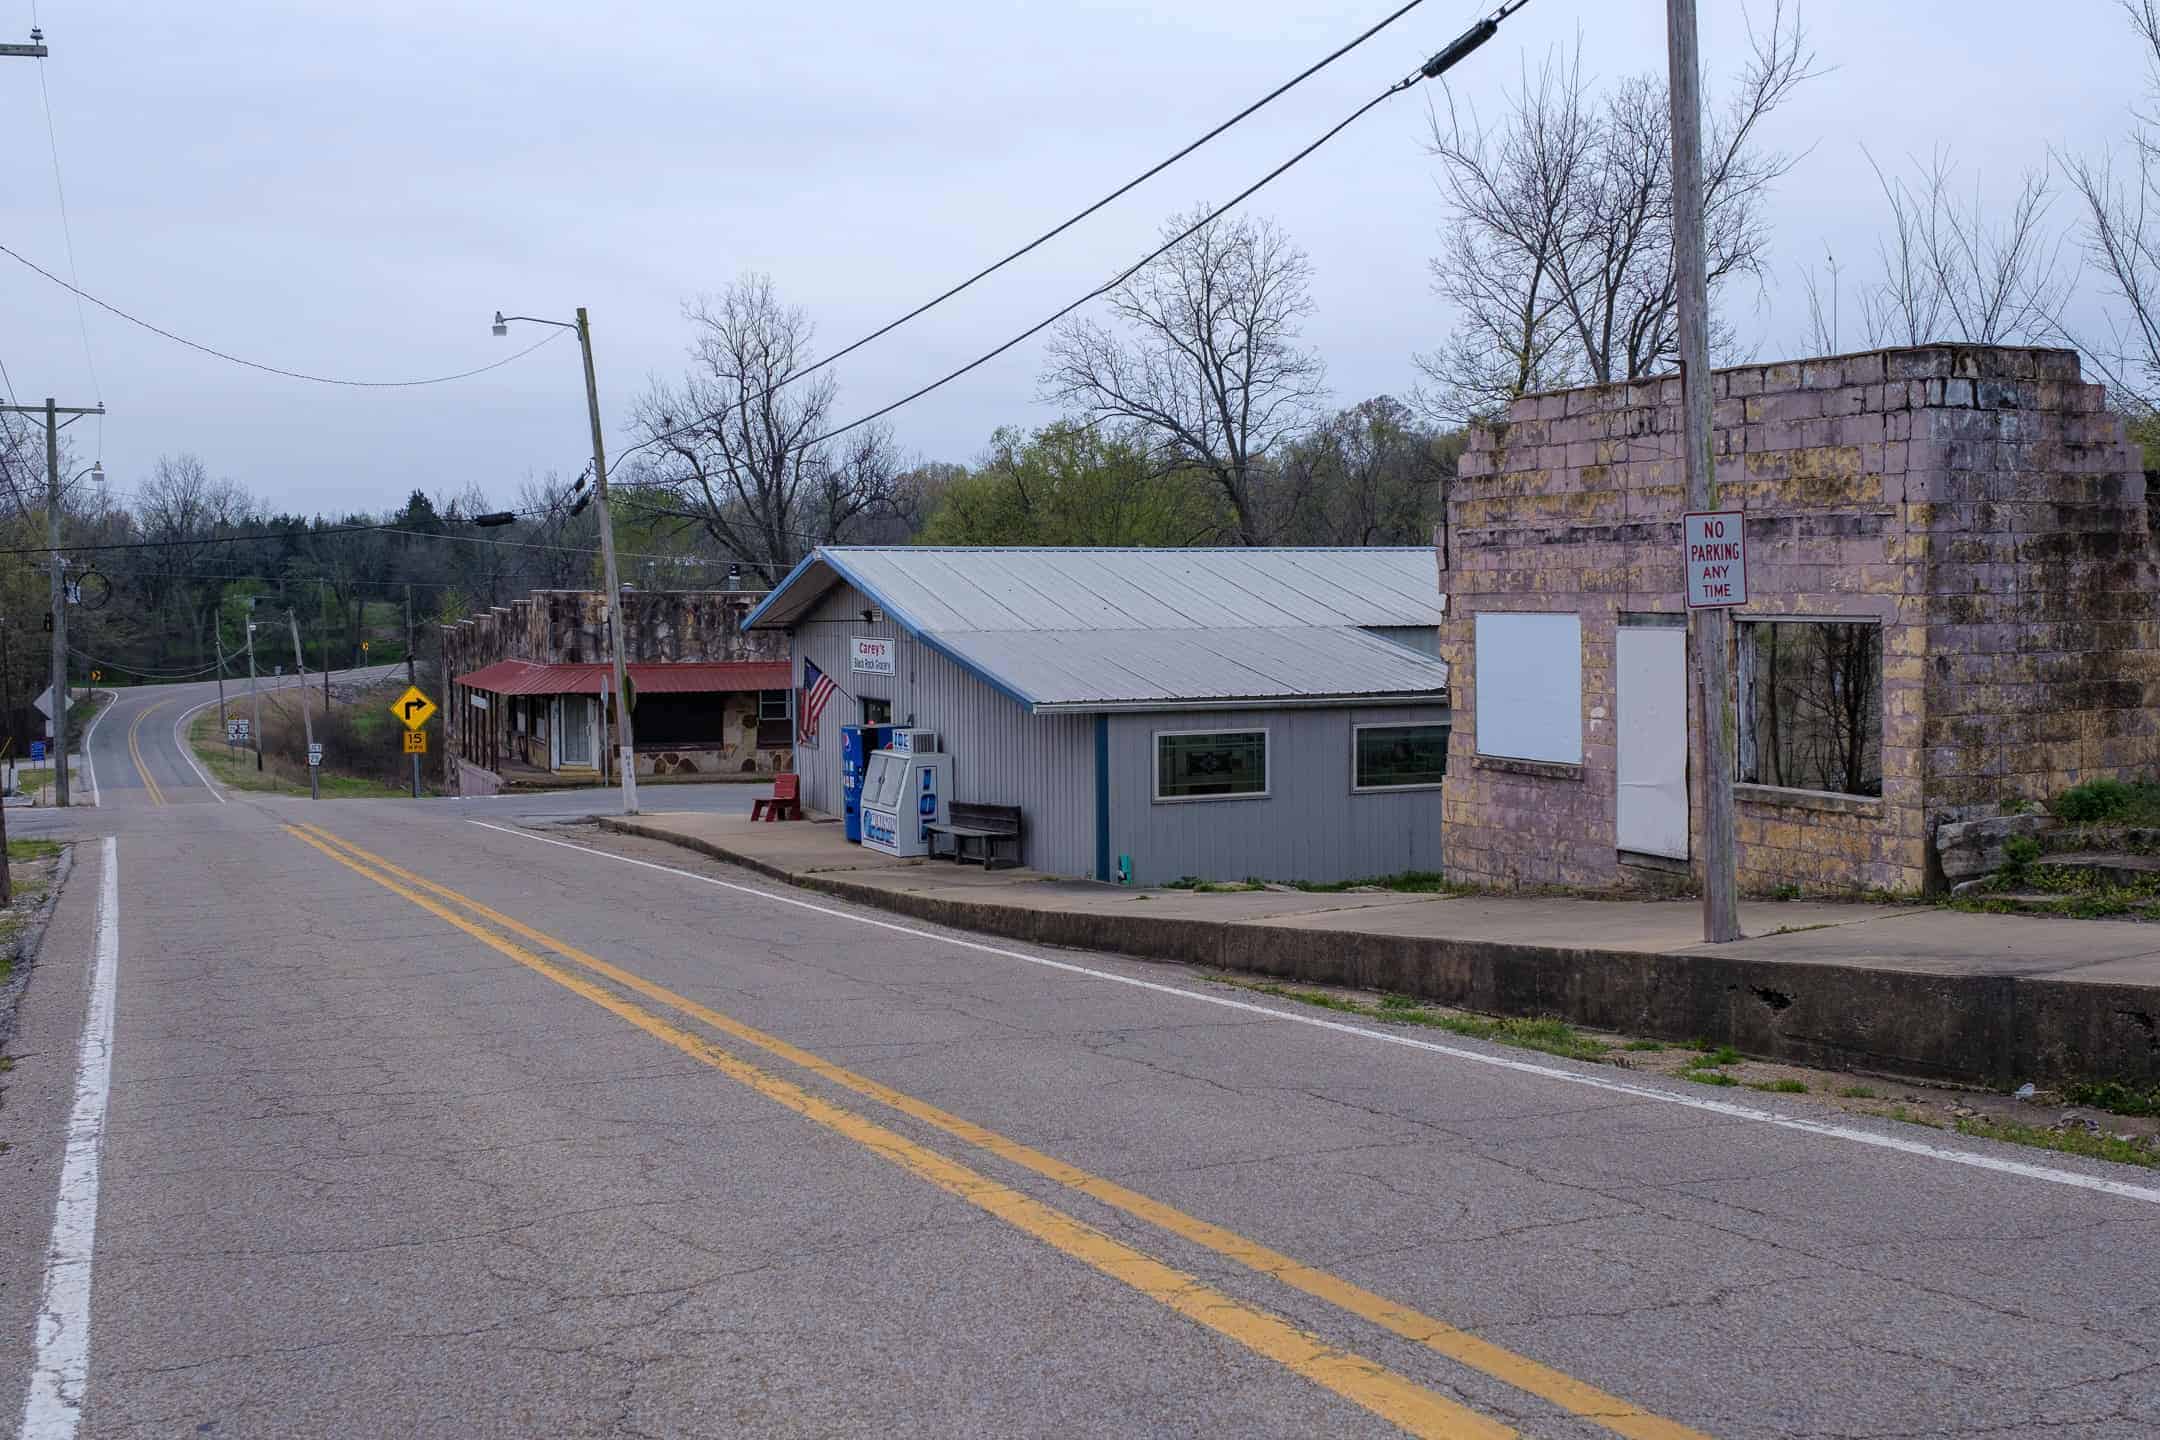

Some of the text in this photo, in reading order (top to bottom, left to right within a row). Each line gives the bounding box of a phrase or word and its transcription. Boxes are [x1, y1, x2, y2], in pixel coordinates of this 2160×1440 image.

[1704, 520, 1725, 538] NO
[1691, 542, 1740, 562] PARKING
[1703, 565, 1730, 580] ANY
[1702, 583, 1732, 598] TIME
[859, 641, 886, 657] Carey's
[408, 733, 423, 744] 15
[894, 731, 909, 748] ICE
